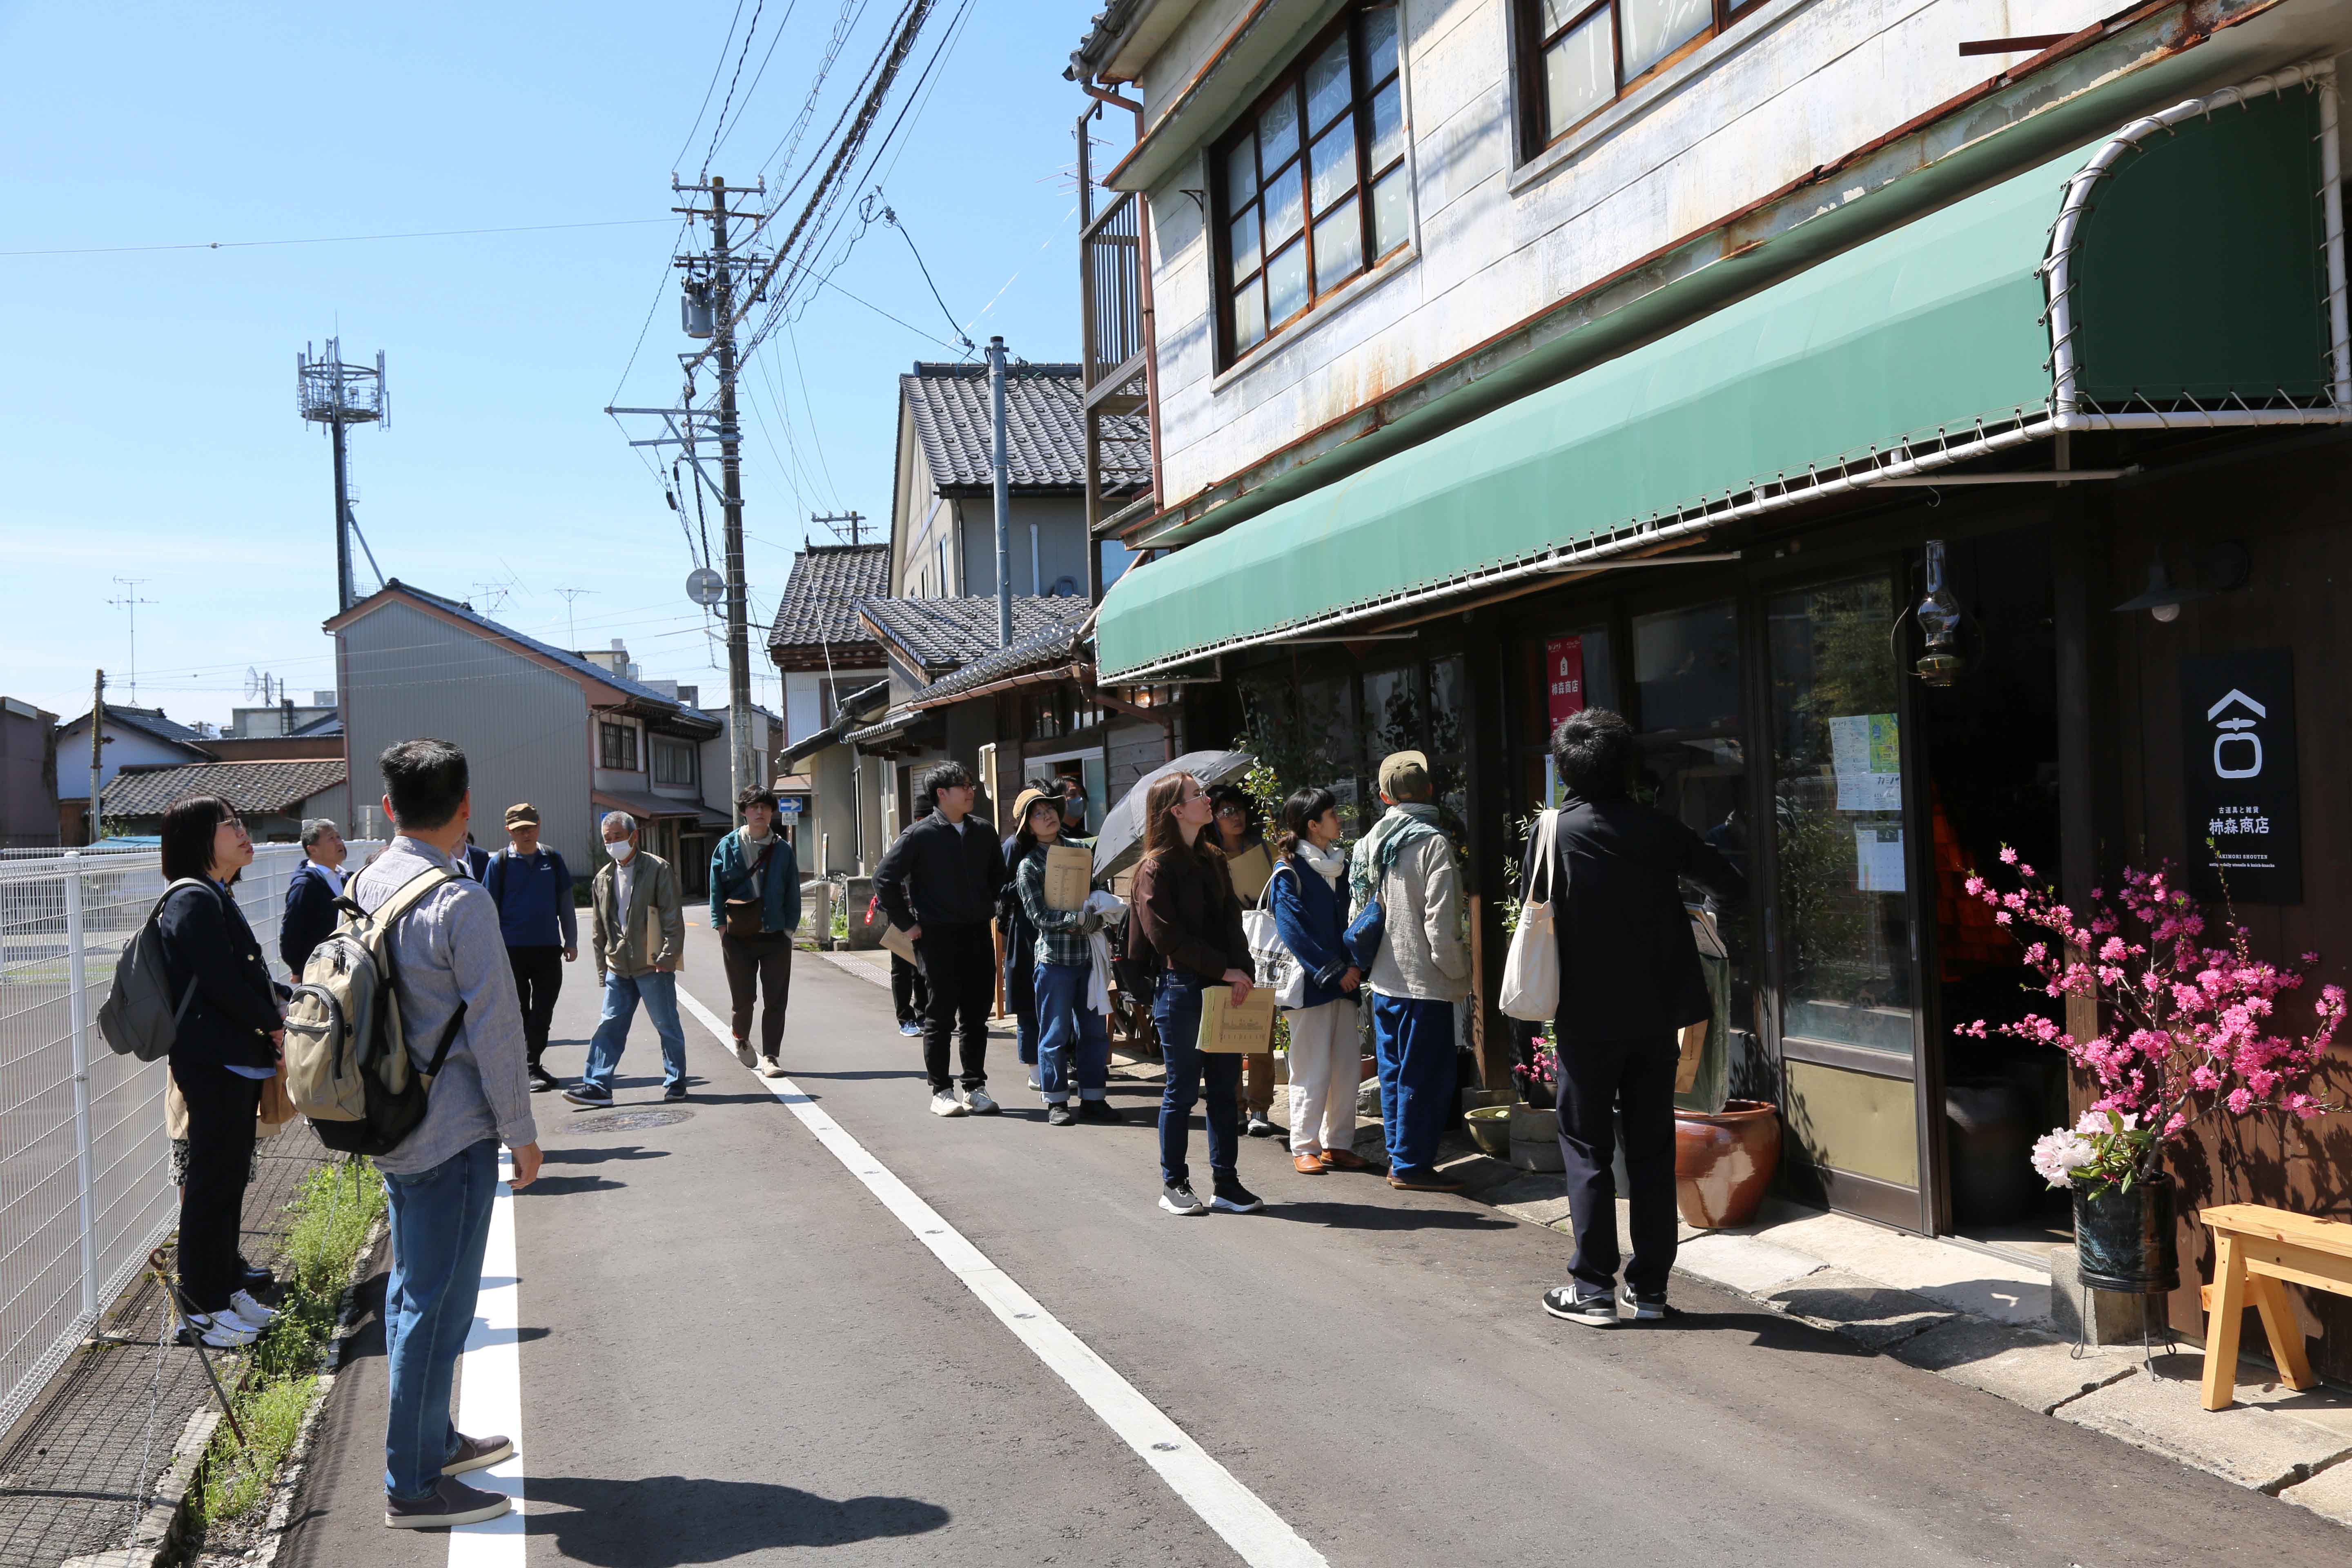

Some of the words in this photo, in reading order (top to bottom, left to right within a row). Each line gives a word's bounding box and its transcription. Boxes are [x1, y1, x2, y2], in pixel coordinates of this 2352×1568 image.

[1552, 679, 1578, 696] 柿森商店
[2209, 816, 2269, 835] 柿森商店
